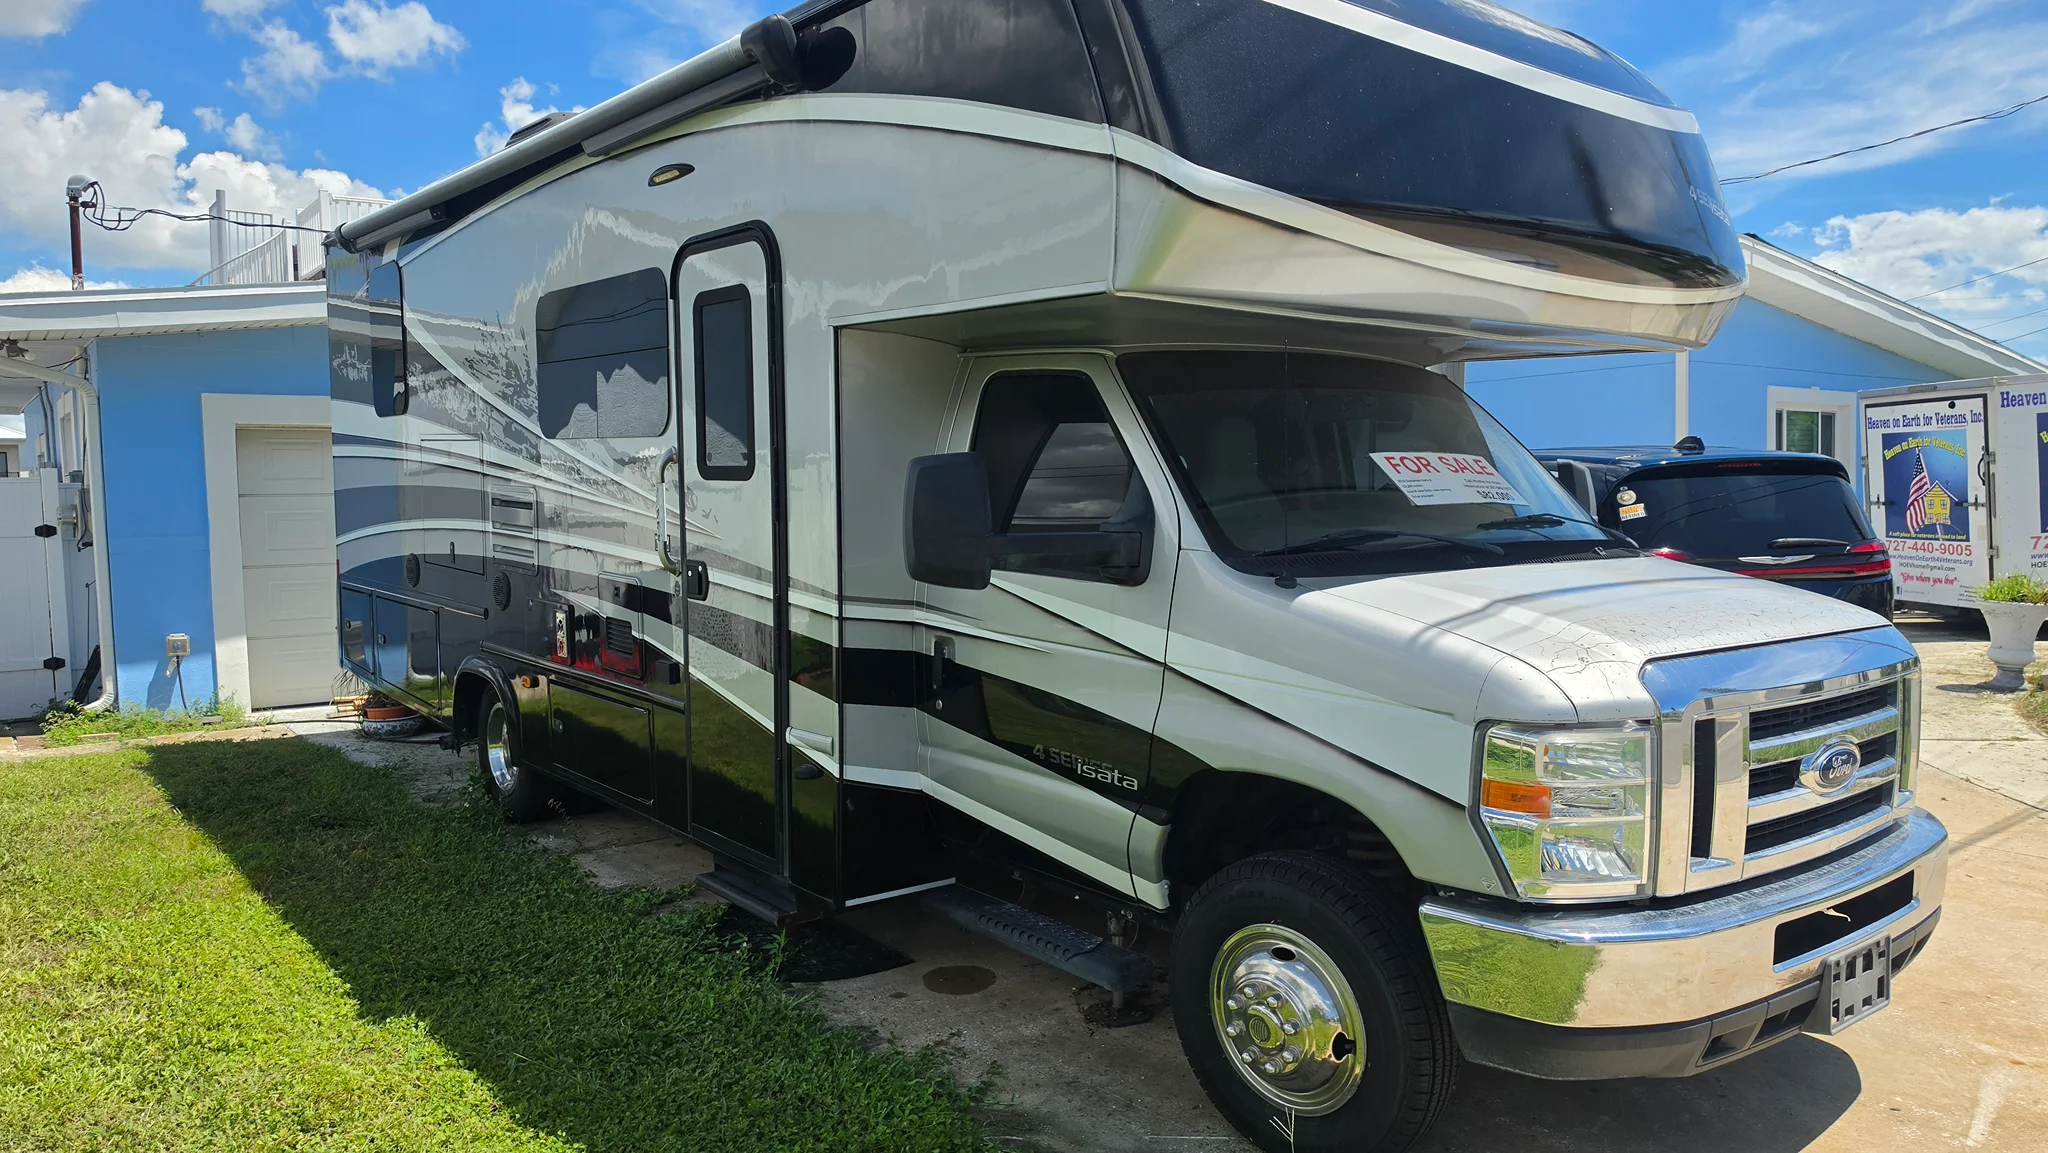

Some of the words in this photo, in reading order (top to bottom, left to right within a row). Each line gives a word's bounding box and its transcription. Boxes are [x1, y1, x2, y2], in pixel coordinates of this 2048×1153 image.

[2000, 391, 2047, 408] Heaven
[1867, 417, 1891, 429] Heaven
[1893, 417, 1901, 428] on
[1902, 414, 1921, 428] Earth
[1922, 413, 1933, 427] for
[1935, 411, 1968, 426] Veterans,
[1970, 409, 1984, 423] Inc.
[1883, 444, 1902, 460] Heaven
[1901, 441, 1909, 449] on
[1908, 437, 1923, 448] Earth
[1923, 436, 1931, 447] for
[1384, 456, 1440, 475] FOR
[1437, 456, 1495, 477] SALE
[1885, 540, 1972, 557] 727-440-9005
[1931, 576, 1943, 588] you
[1033, 744, 1045, 760] 4
[1077, 759, 1139, 791] isata
[1829, 754, 1853, 779] Ford
